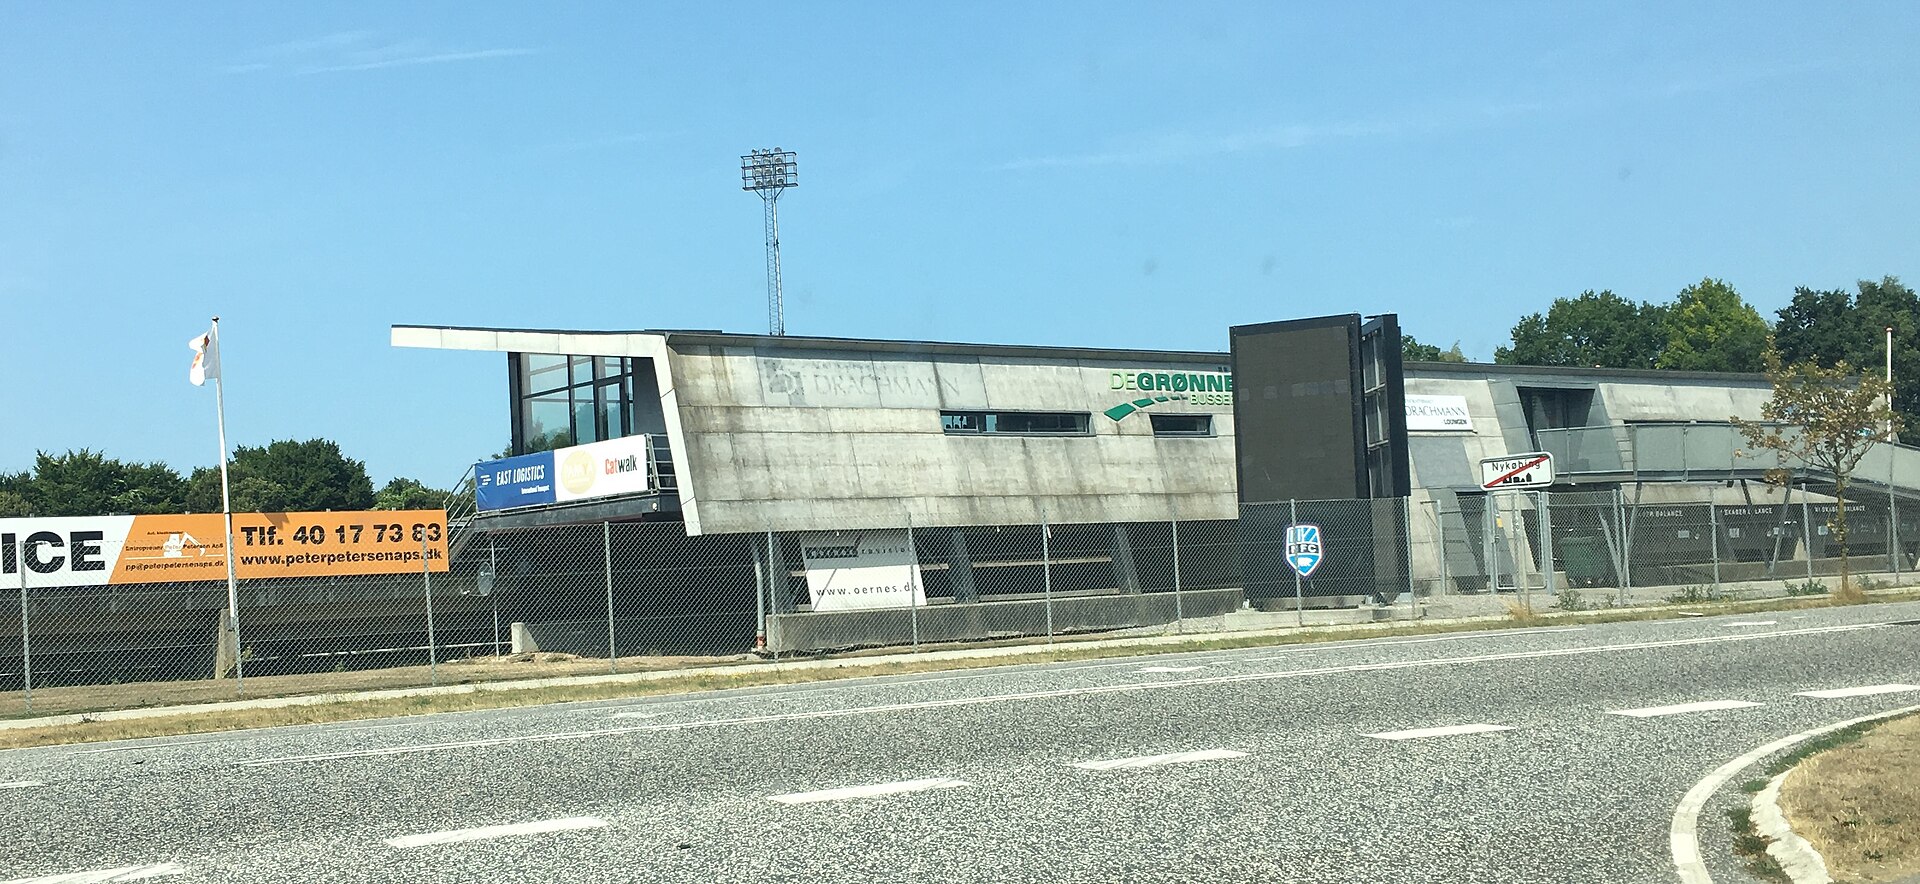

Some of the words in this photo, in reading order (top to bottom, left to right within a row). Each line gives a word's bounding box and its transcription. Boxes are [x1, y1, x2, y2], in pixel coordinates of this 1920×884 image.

[1191, 394, 1233, 405] BUSSE
[605, 454, 637, 474] Catwalk
[496, 469, 512, 486] EAST
[513, 464, 545, 484] LOGISTICS
[241, 526, 284, 546] Tlf.
[293, 525, 325, 545] 40
[336, 524, 364, 544] 17
[374, 524, 404, 543] 73
[412, 523, 441, 542] 83
[2, 531, 105, 574] ICE
[241, 549, 442, 567] www.peterpetersenaps.dk
